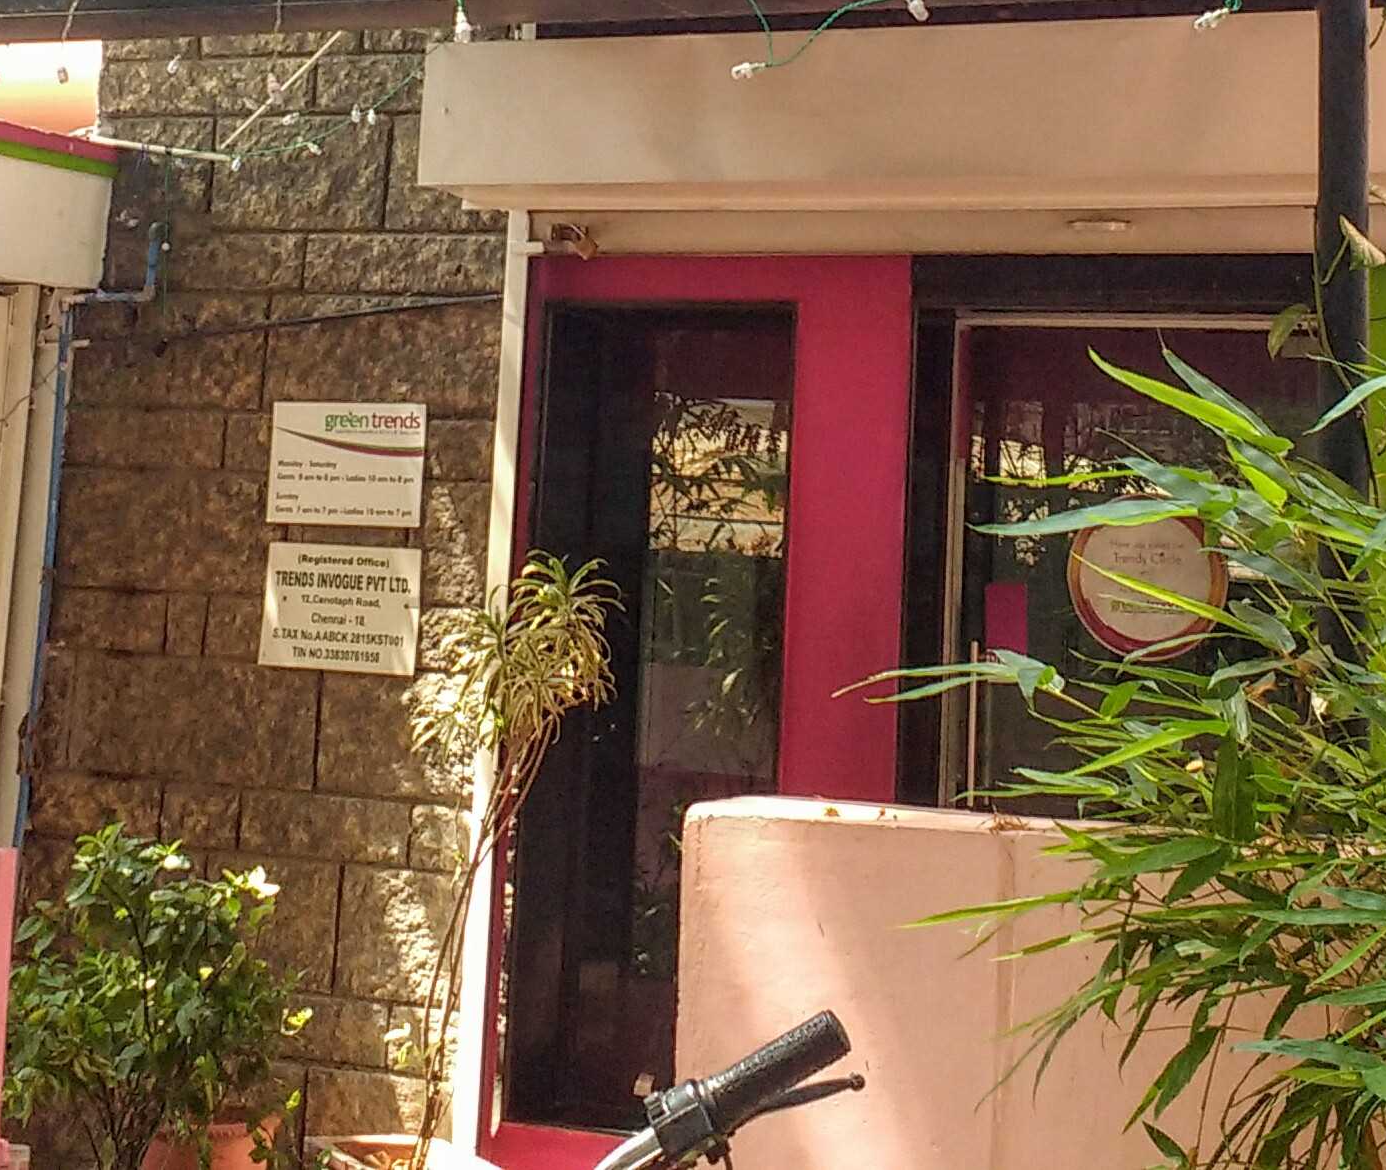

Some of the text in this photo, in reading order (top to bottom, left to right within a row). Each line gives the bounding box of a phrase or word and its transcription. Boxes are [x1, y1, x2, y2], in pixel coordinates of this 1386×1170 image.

[325, 411, 421, 432] green trends
[298, 554, 390, 568] (Registered Office)
[275, 570, 412, 594] TRENDS INVOGUE PVT LTD.
[311, 612, 347, 625] Chennai
[292, 646, 306, 658] TIN
